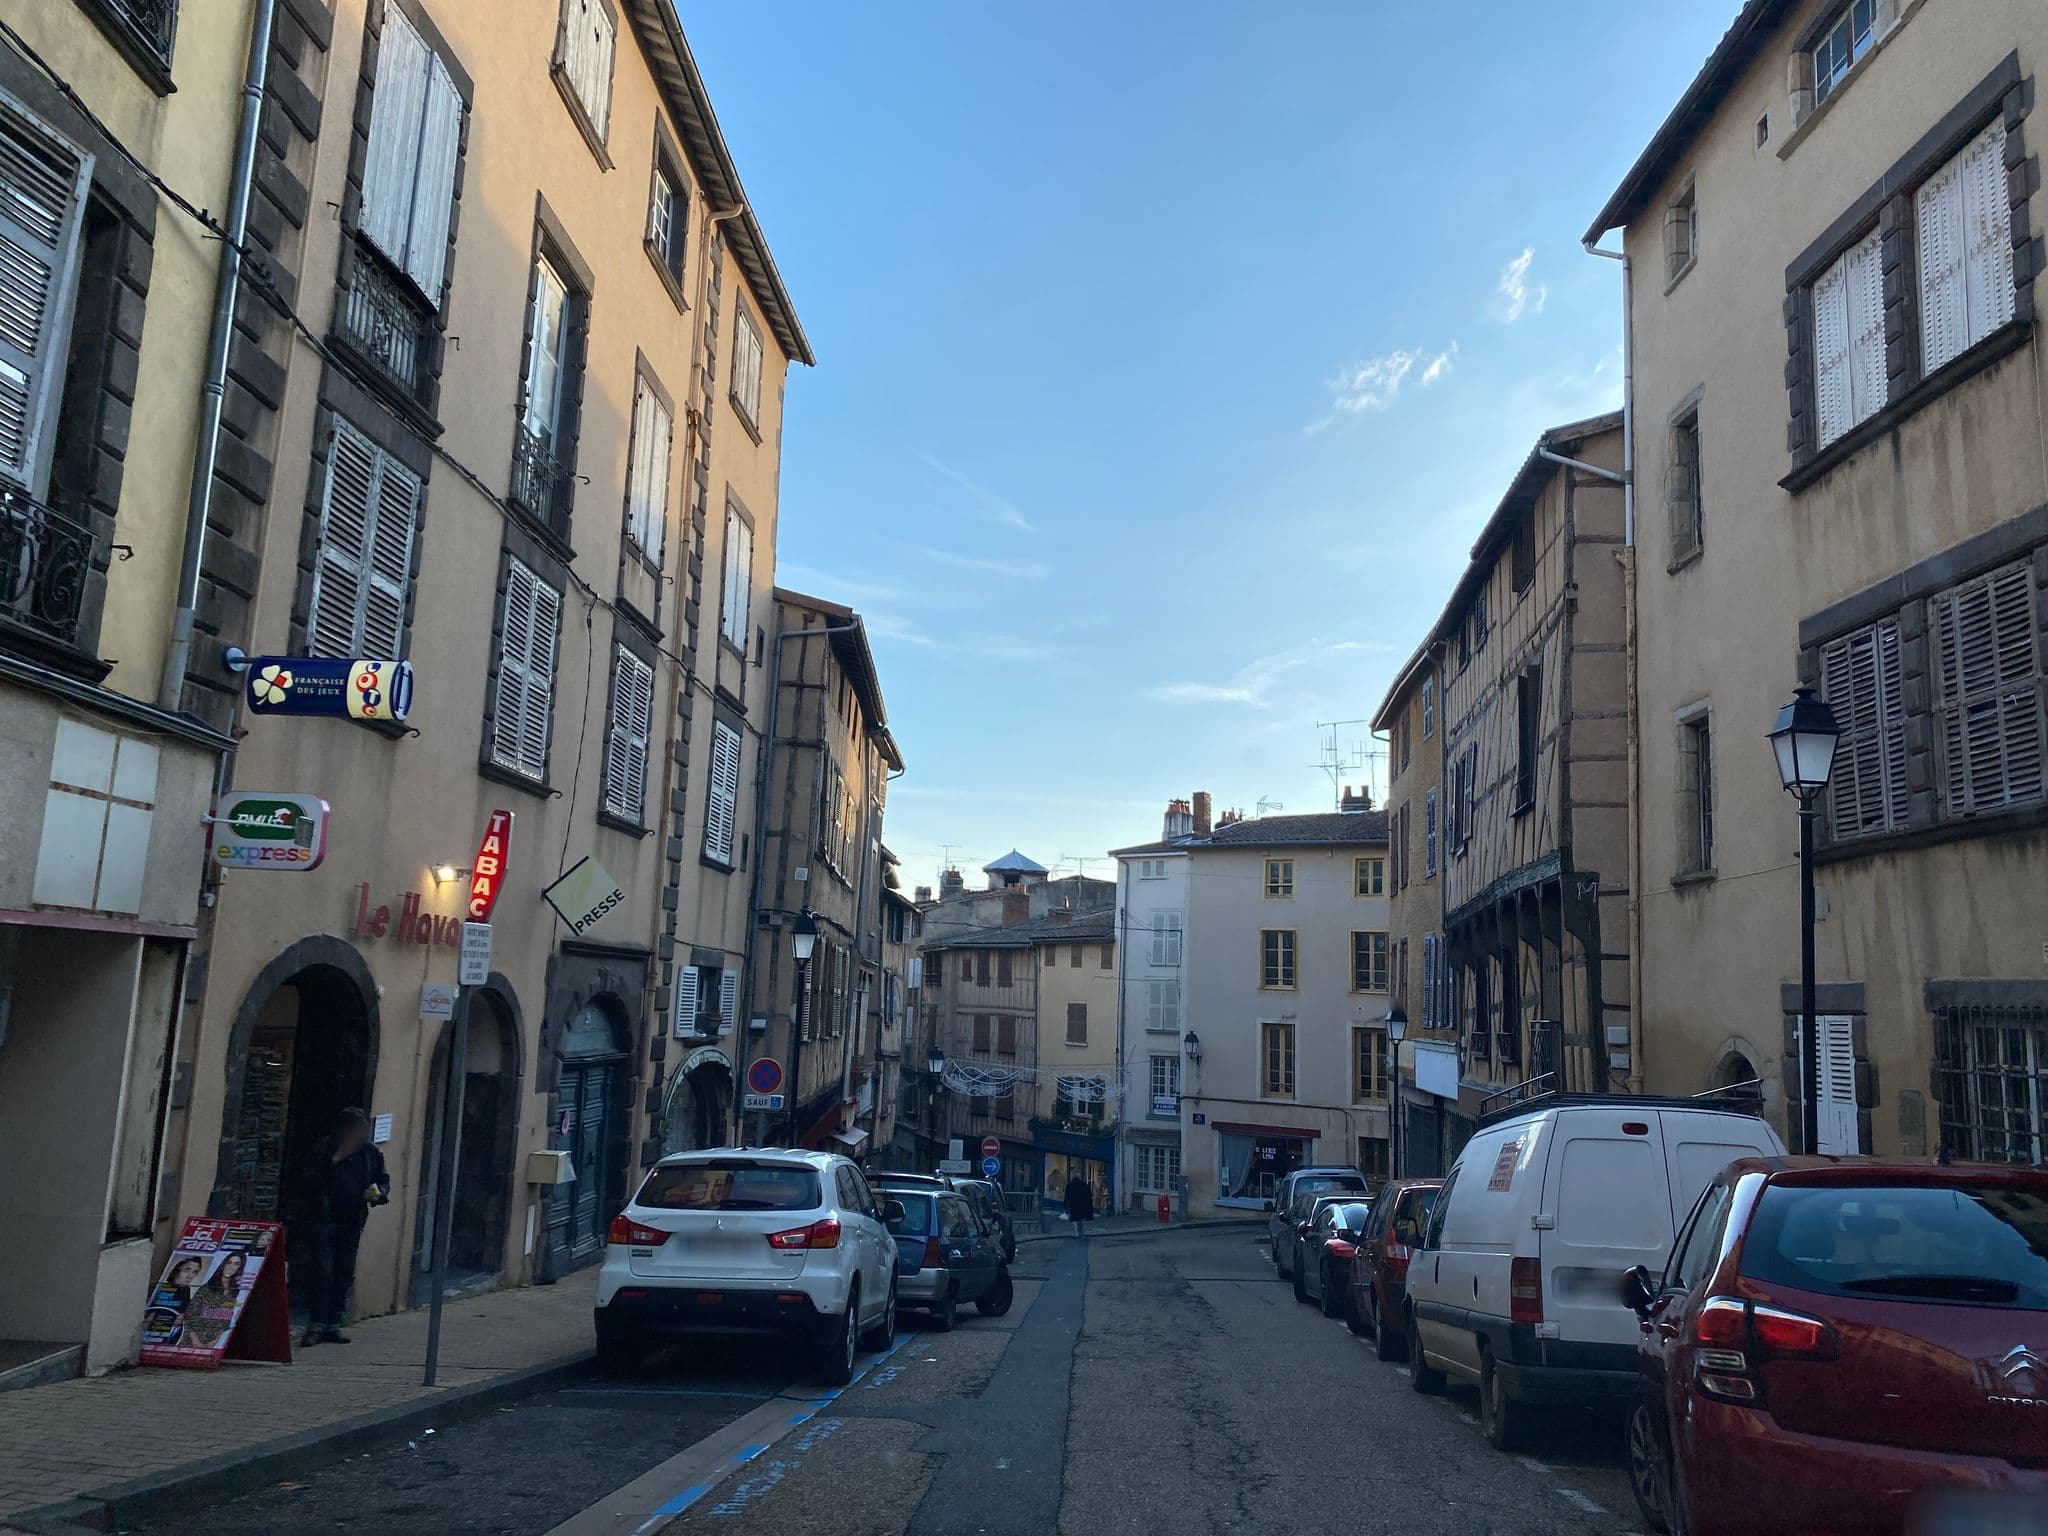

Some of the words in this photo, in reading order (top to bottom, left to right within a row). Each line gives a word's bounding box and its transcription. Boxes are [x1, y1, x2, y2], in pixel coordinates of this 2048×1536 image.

[294, 676, 345, 687] FRANÇAISE
[356, 662, 382, 717] LOTO
[296, 687, 315, 695] DES
[317, 687, 341, 696] JEUX
[236, 813, 274, 827] PMU
[217, 844, 312, 865] express
[468, 814, 507, 917] TABAC
[574, 887, 626, 936] PRESSE
[747, 1098, 769, 1106] SAUF
